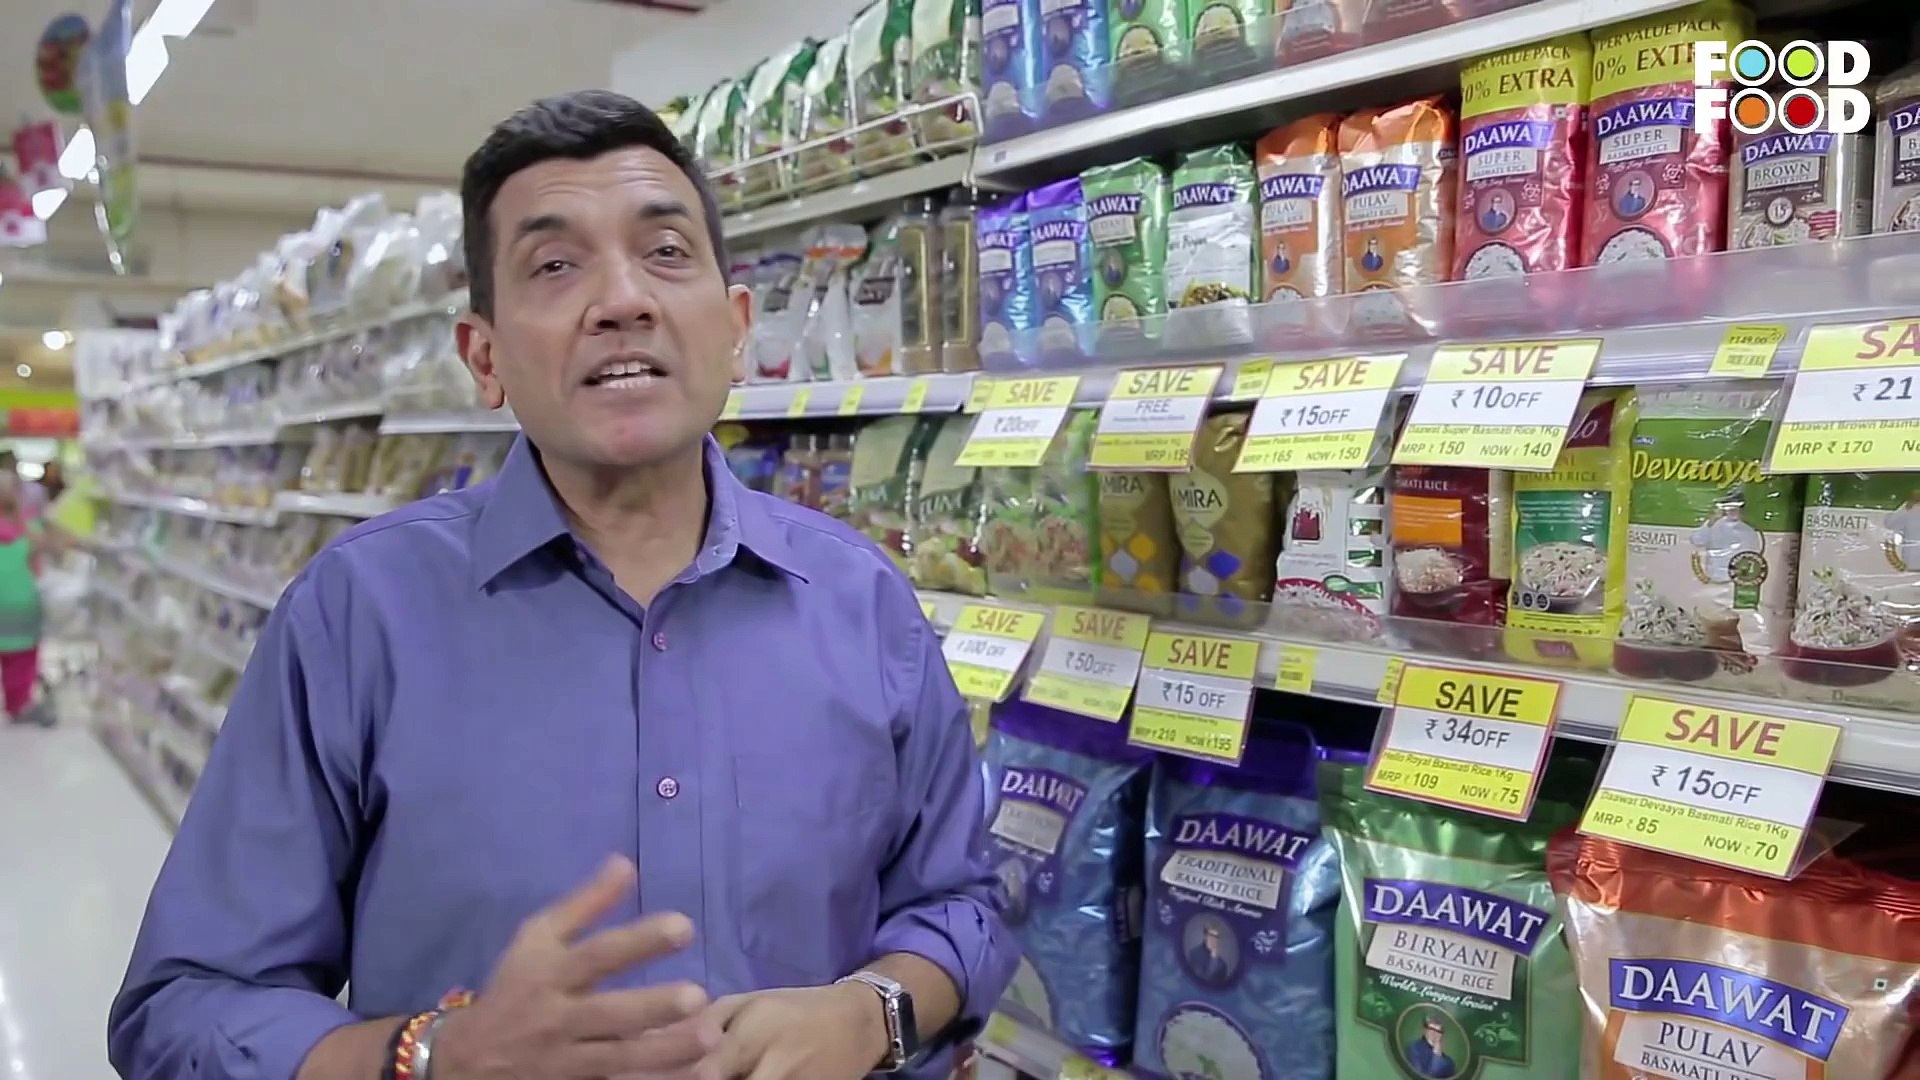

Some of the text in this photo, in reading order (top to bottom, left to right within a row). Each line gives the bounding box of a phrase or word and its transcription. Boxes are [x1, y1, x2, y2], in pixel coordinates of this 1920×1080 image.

[1626, 23, 1673, 43] VALUE
[1677, 18, 1721, 32] PACK
[1534, 46, 1571, 60] PACK
[1499, 67, 1574, 95] EXTRA
[1597, 102, 1695, 136] DAAWAT
[1465, 123, 1552, 154] DAAWAT
[1613, 129, 1663, 148] SUPER
[1745, 135, 1830, 163] DAAWAT
[1479, 150, 1521, 164] SUPER
[1342, 168, 1418, 196] DAAWAT
[1754, 162, 1811, 181] BROWN
[1174, 185, 1235, 208] DAAWAT
[1261, 177, 1321, 199] AAWAT
[1352, 193, 1390, 208] PULAV
[1462, 346, 1557, 375] SAVE
[1129, 370, 1195, 394] SAVE
[1294, 361, 1371, 391] SAVE
[1874, 376, 1913, 401] 21
[1006, 382, 1057, 403] SAVE
[1136, 399, 1172, 413] FREE
[1514, 426, 1536, 435] Rice
[1540, 427, 1560, 438] 1Kg
[1273, 450, 1293, 462] 165
[1339, 447, 1361, 460] 150
[1401, 443, 1426, 454] MRP
[1438, 441, 1465, 455] 150
[1480, 445, 1511, 456] NOW
[1522, 443, 1552, 457] 140
[1784, 442, 1822, 456] MRP
[1841, 440, 1874, 454] 170
[1567, 472, 1596, 482] RICE
[1632, 450, 1766, 488] Devaaya
[1173, 489, 1222, 508] MIRA
[1424, 480, 1448, 490] RICE
[1807, 514, 1868, 529] BASMATI
[1629, 530, 1677, 546] BASMATI
[972, 610, 1023, 634] SAVE
[1072, 611, 1127, 640] SAVE
[1168, 639, 1231, 669] SAVE
[1199, 692, 1226, 708] OFF
[1435, 681, 1523, 718] SAVE
[1665, 709, 1786, 757] SAVE
[1406, 755, 1431, 769] Royal
[1472, 766, 1492, 777] Rice
[1495, 769, 1514, 782] 1Kg
[1002, 770, 1084, 812] DAAWAT
[1378, 770, 1401, 783] MRP
[1413, 772, 1439, 790] 109
[1459, 785, 1491, 799] NOW
[1500, 787, 1520, 805] 75
[1639, 797, 1685, 816] Devaaya
[1688, 808, 1734, 826] Basmati
[1736, 818, 1761, 832] Rice
[1765, 823, 1789, 839] 1Kg
[1176, 819, 1310, 861] DAAWAT
[1593, 811, 1623, 826] MRP
[1635, 817, 1659, 834] 85
[1703, 835, 1741, 853] NOW
[1753, 841, 1778, 861] 70
[1177, 855, 1278, 884] TRADITIONAL
[1176, 873, 1262, 901] BASMATI RICE
[1371, 884, 1543, 944] DAAWAT
[1394, 930, 1498, 969] BIRYANI
[1386, 954, 1495, 991] BASMATI RICE
[1618, 965, 1836, 1044] DAAWAT
[1658, 1021, 1764, 1067] PULAV
